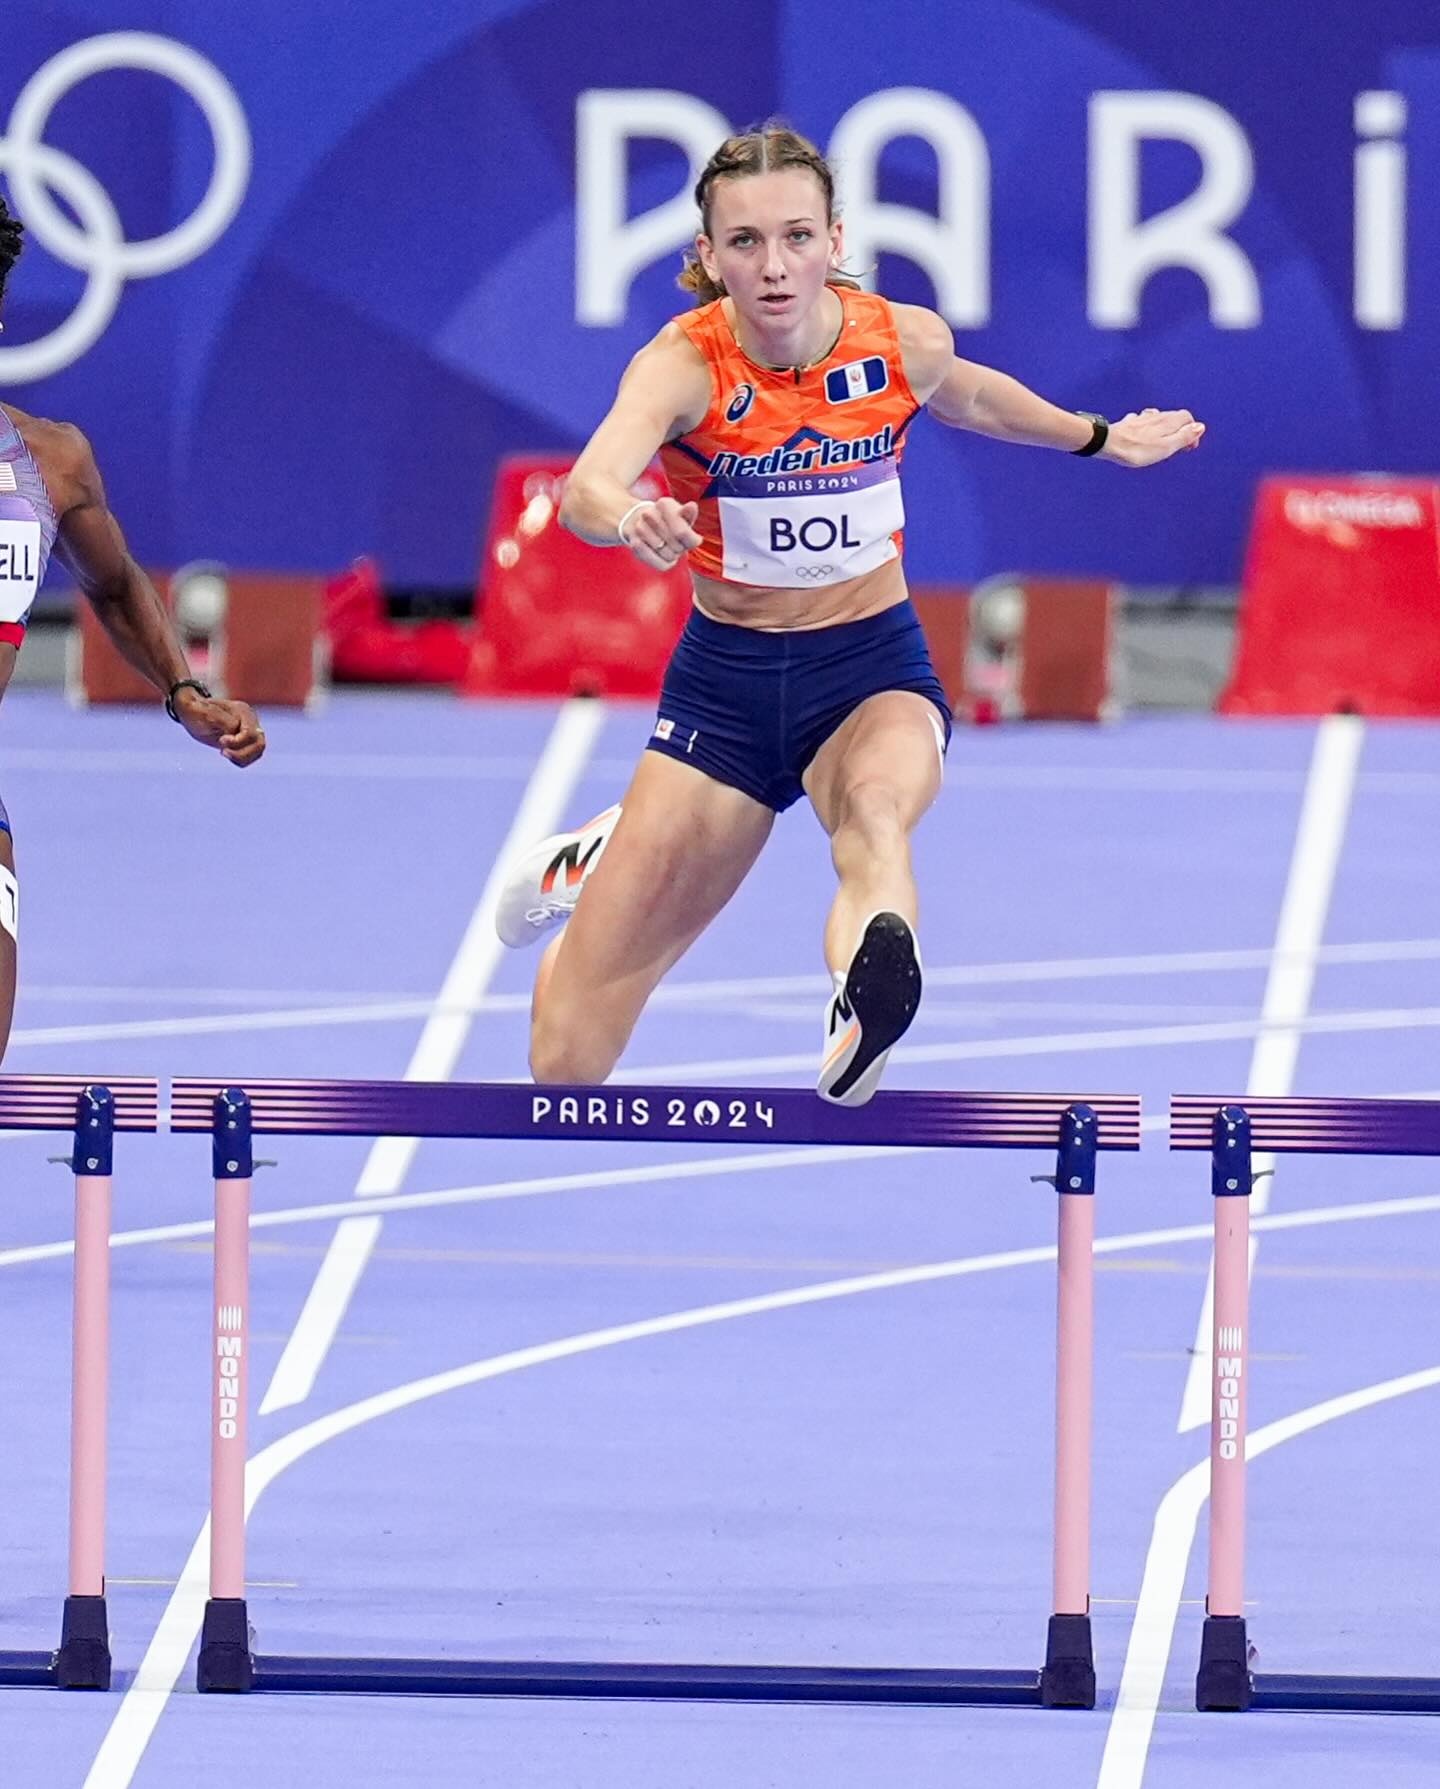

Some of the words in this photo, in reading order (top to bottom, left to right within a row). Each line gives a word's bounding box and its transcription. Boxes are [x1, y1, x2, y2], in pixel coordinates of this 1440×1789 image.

[818, 476, 858, 490] 2024
[770, 515, 860, 552] BOL
[667, 1099, 774, 1128] 2024
[217, 1336, 241, 1439] MONDO
[1218, 1357, 1242, 1460] MONDO
